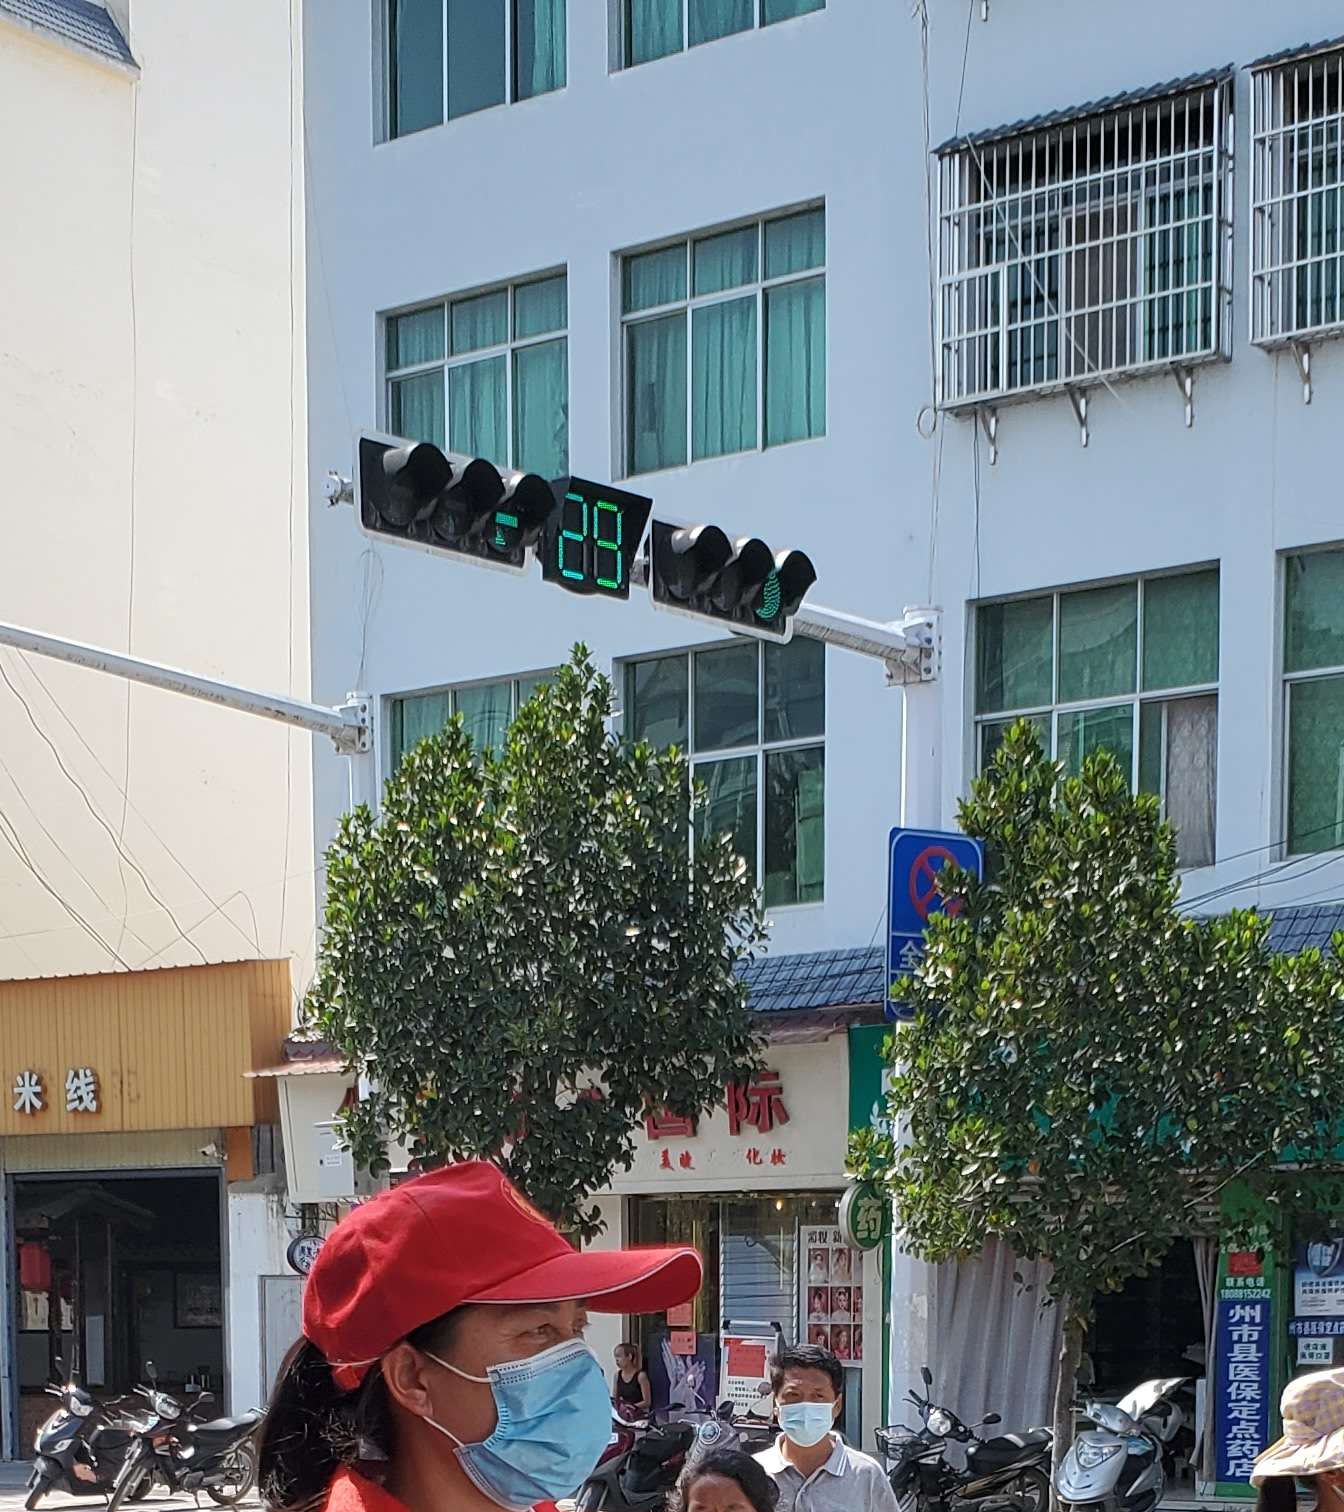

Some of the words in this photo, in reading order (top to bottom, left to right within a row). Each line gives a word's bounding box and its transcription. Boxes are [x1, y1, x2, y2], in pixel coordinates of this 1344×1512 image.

[558, 493, 622, 589] 29
[13, 1070, 97, 1115] 米线
[1225, 1304, 1263, 1477] 州市县医保定点药店
